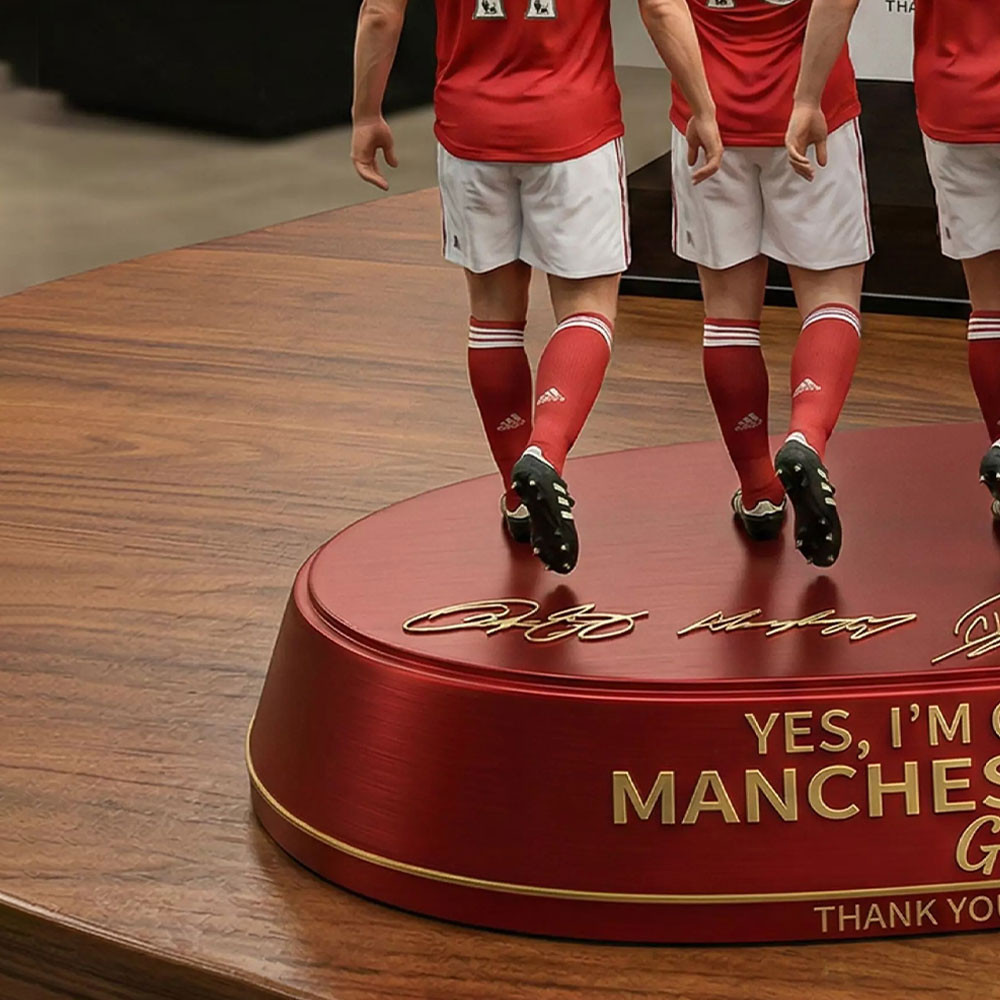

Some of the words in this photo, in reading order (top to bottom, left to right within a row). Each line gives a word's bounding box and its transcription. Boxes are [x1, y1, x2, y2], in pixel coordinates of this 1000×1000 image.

[744, 709, 871, 760] YES,
[890, 703, 972, 748] I'M
[813, 898, 939, 933] THANK
